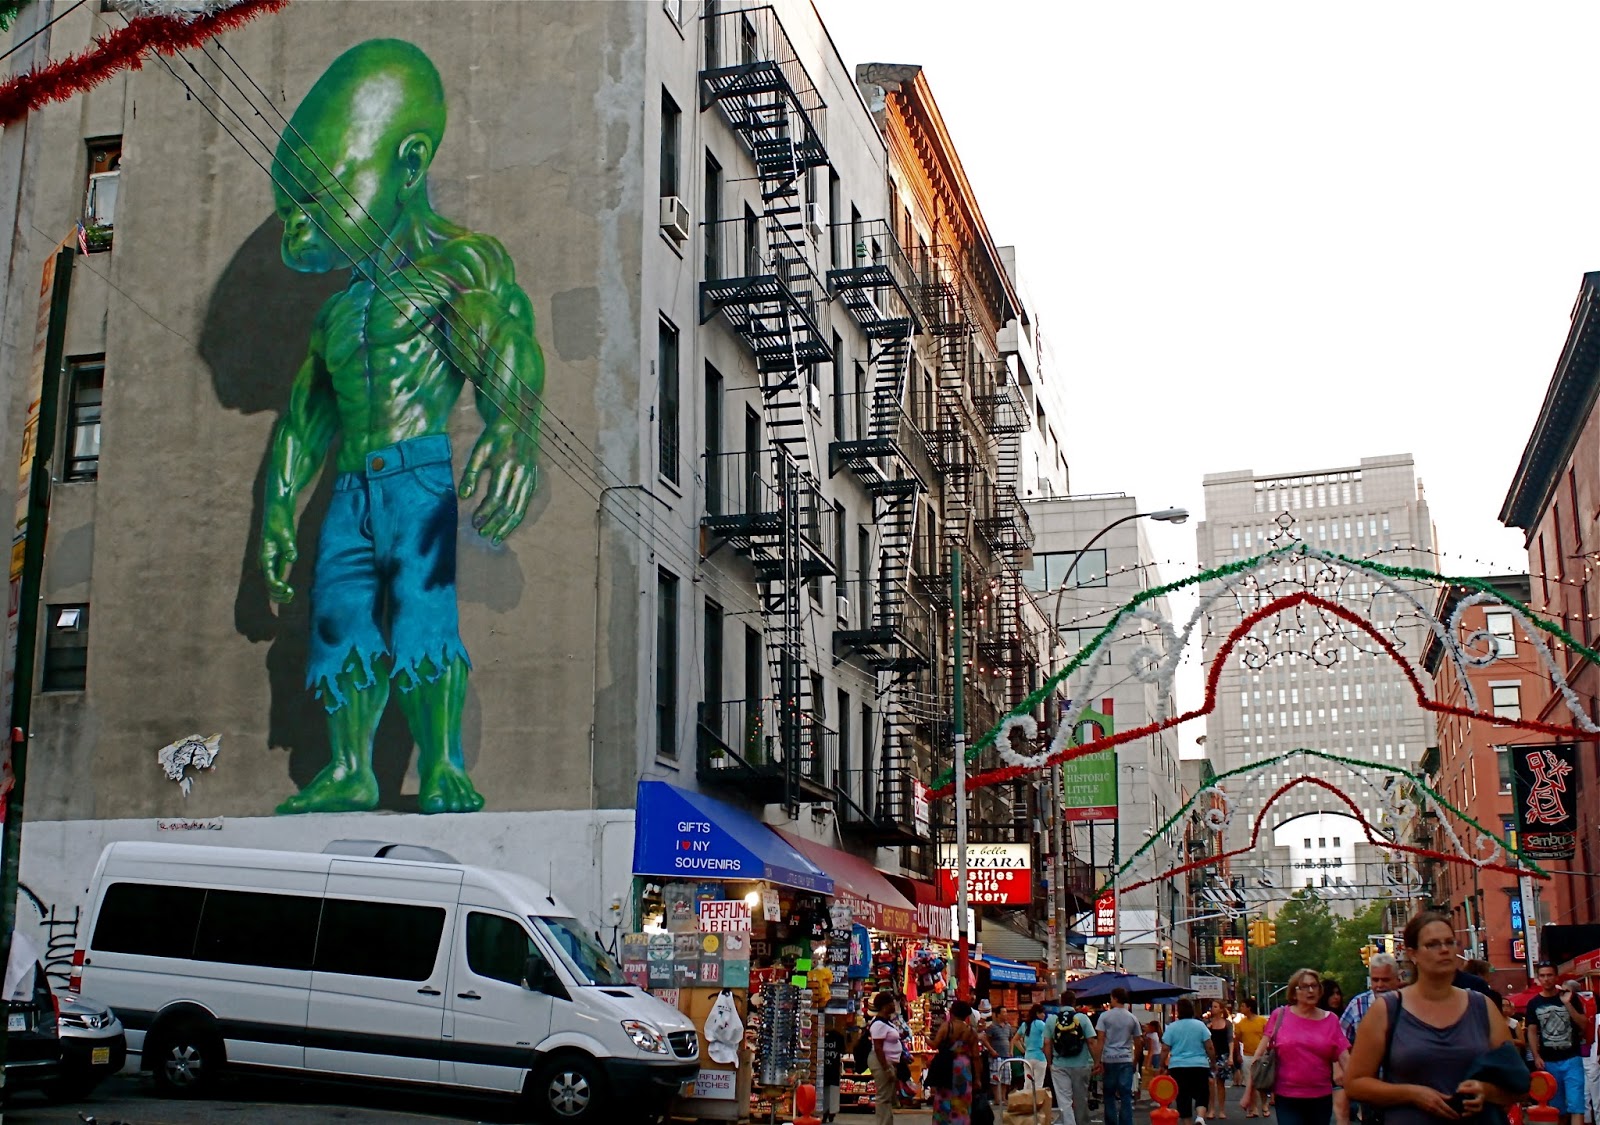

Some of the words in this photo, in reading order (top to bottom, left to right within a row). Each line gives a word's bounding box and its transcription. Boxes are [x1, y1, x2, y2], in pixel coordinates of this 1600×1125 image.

[1074, 752, 1112, 762] COME
[1066, 764, 1078, 773] TO
[1066, 772, 1110, 783] HISTORIC
[1067, 784, 1099, 794] LITTLE
[1067, 795, 1095, 805] ITALY
[677, 821, 711, 834] GIFTS
[676, 839, 680, 851] I
[693, 840, 711, 852] NY
[980, 846, 1007, 855] bella
[674, 856, 741, 871] SOUVENIRS
[941, 857, 1026, 868] FERRARA
[950, 868, 1014, 881] Pstries
[966, 879, 999, 892] Café
[955, 890, 1009, 904] akery
[701, 902, 751, 919] PERFUME
[882, 907, 895, 928] GIFT
[895, 910, 910, 930] SHOP
[624, 963, 647, 973] FDNY
[700, 1073, 731, 1081] RFUME
[696, 1081, 730, 1090] ATCHES
